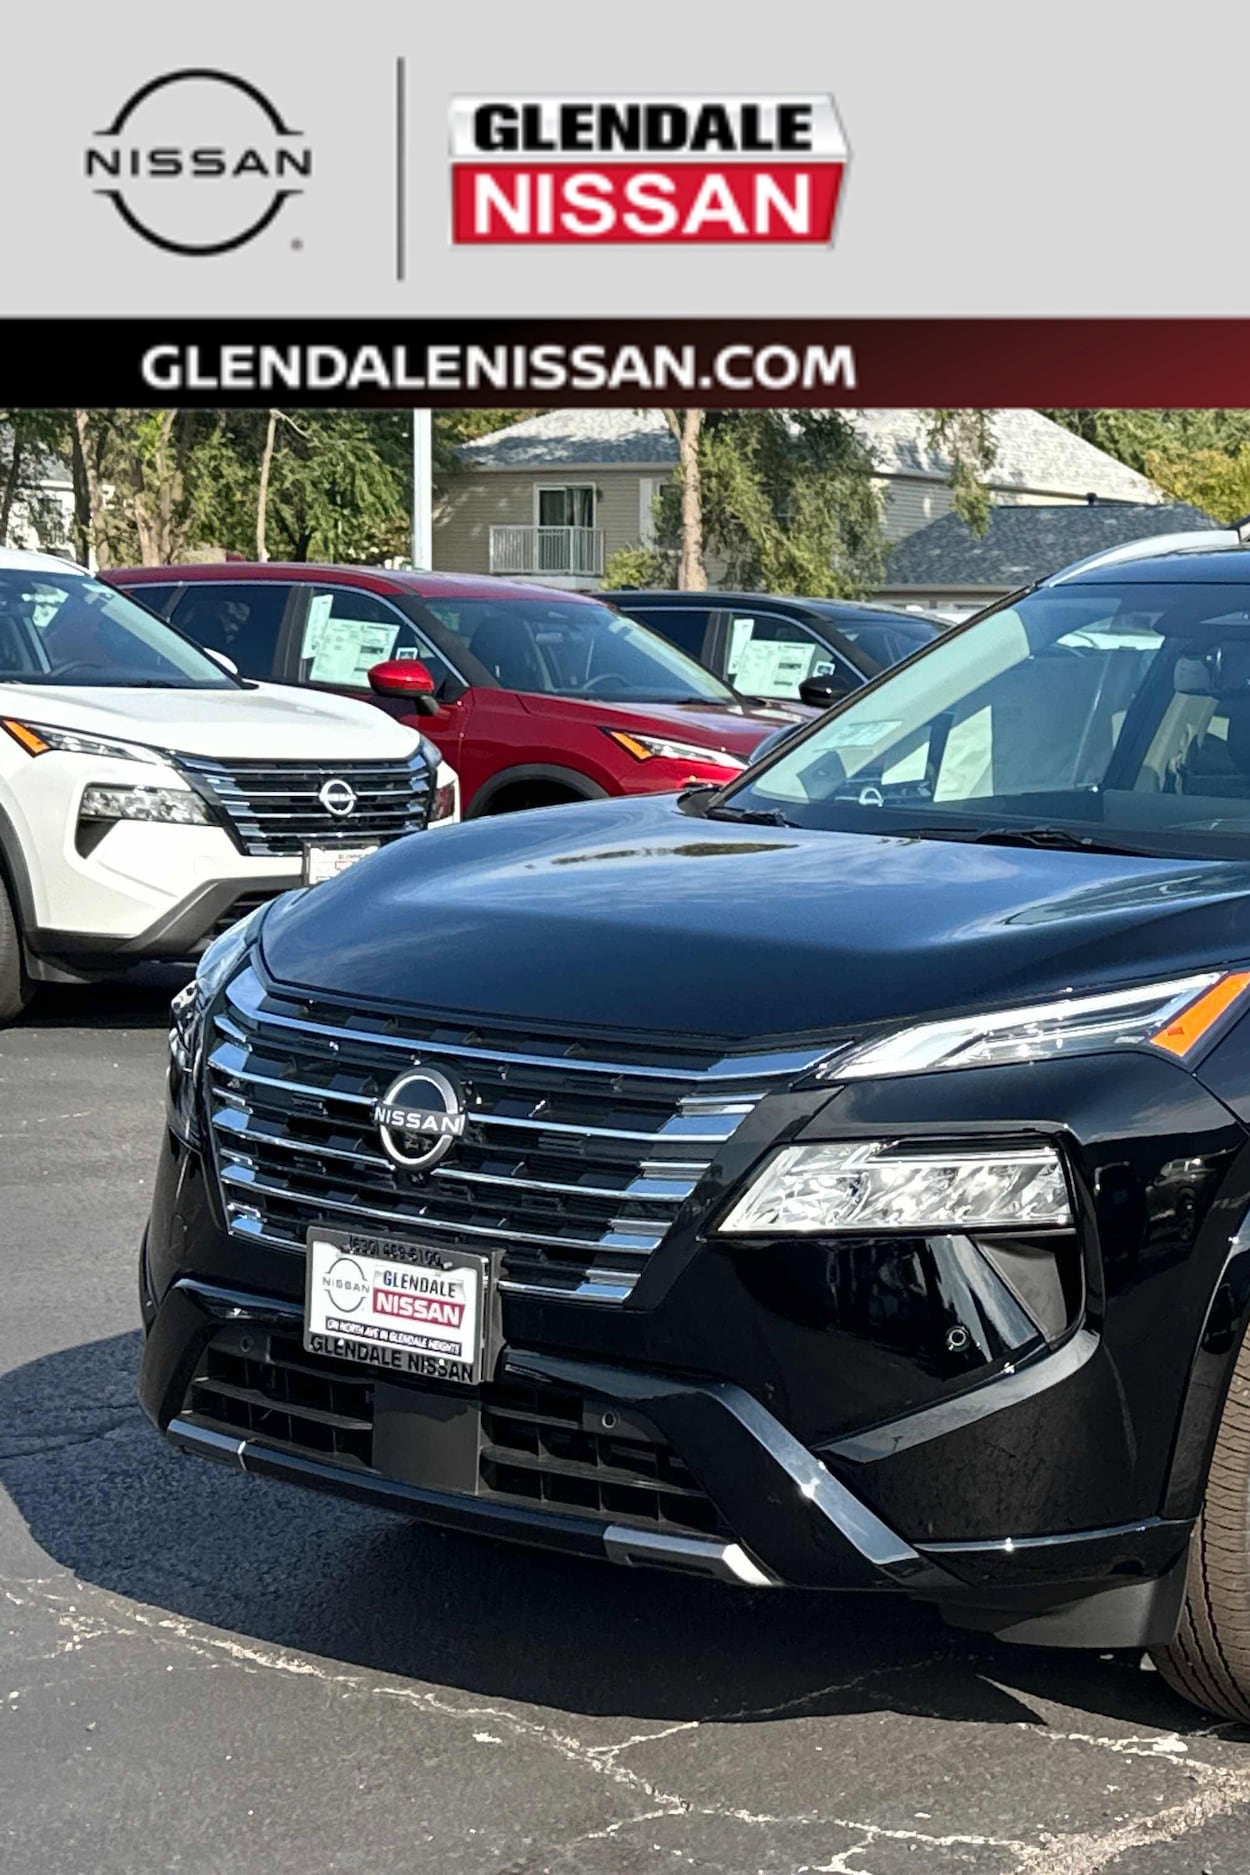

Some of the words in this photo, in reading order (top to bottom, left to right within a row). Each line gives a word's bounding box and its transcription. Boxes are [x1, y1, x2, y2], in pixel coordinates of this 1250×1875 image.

[374, 1106, 461, 1133] NISSAN
[322, 1277, 370, 1294] NISSAN
[383, 1270, 456, 1298] GLENDALE
[376, 1292, 460, 1326] NISSAN
[389, 1332, 428, 1349] GLENDALE
[311, 1335, 401, 1368] GLENDALE
[408, 1353, 473, 1382] NISSAN
